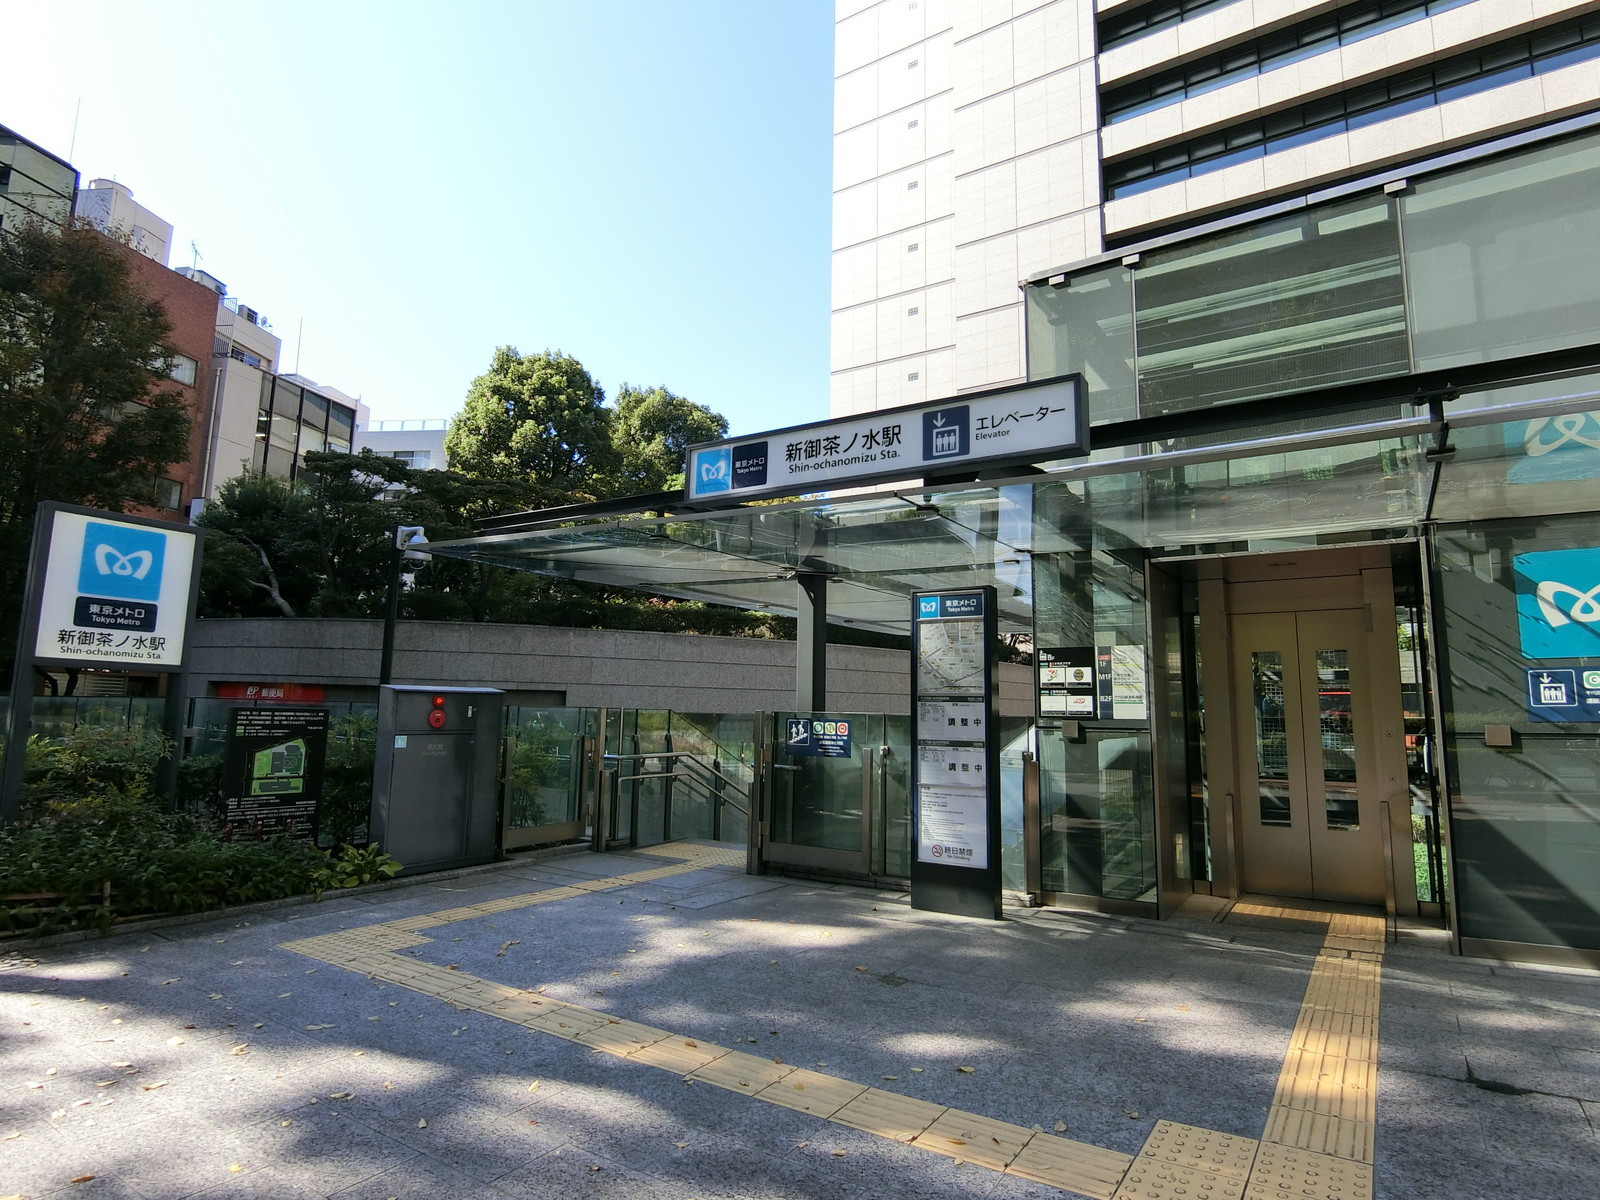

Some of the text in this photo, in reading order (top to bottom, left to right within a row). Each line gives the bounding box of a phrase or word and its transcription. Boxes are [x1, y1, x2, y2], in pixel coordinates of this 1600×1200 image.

[976, 406, 1066, 430] エレベーター
[976, 429, 1010, 440] Elevator
[785, 424, 902, 462] 新御茶ノ水駅
[734, 457, 765, 468] 東京メトロ
[788, 449, 900, 474] Shin-ochanomizu Sta.
[946, 599, 976, 607] 東京メトロ
[88, 604, 145, 618] 東京メトロ
[92, 614, 140, 626] Tokyo Metro
[57, 629, 166, 651] 新御茶ノ水駅
[60, 646, 163, 659] Shin-ochanomizu Sta.
[261, 688, 284, 698] 郵便局
[944, 846, 973, 857] 終日禁煙
